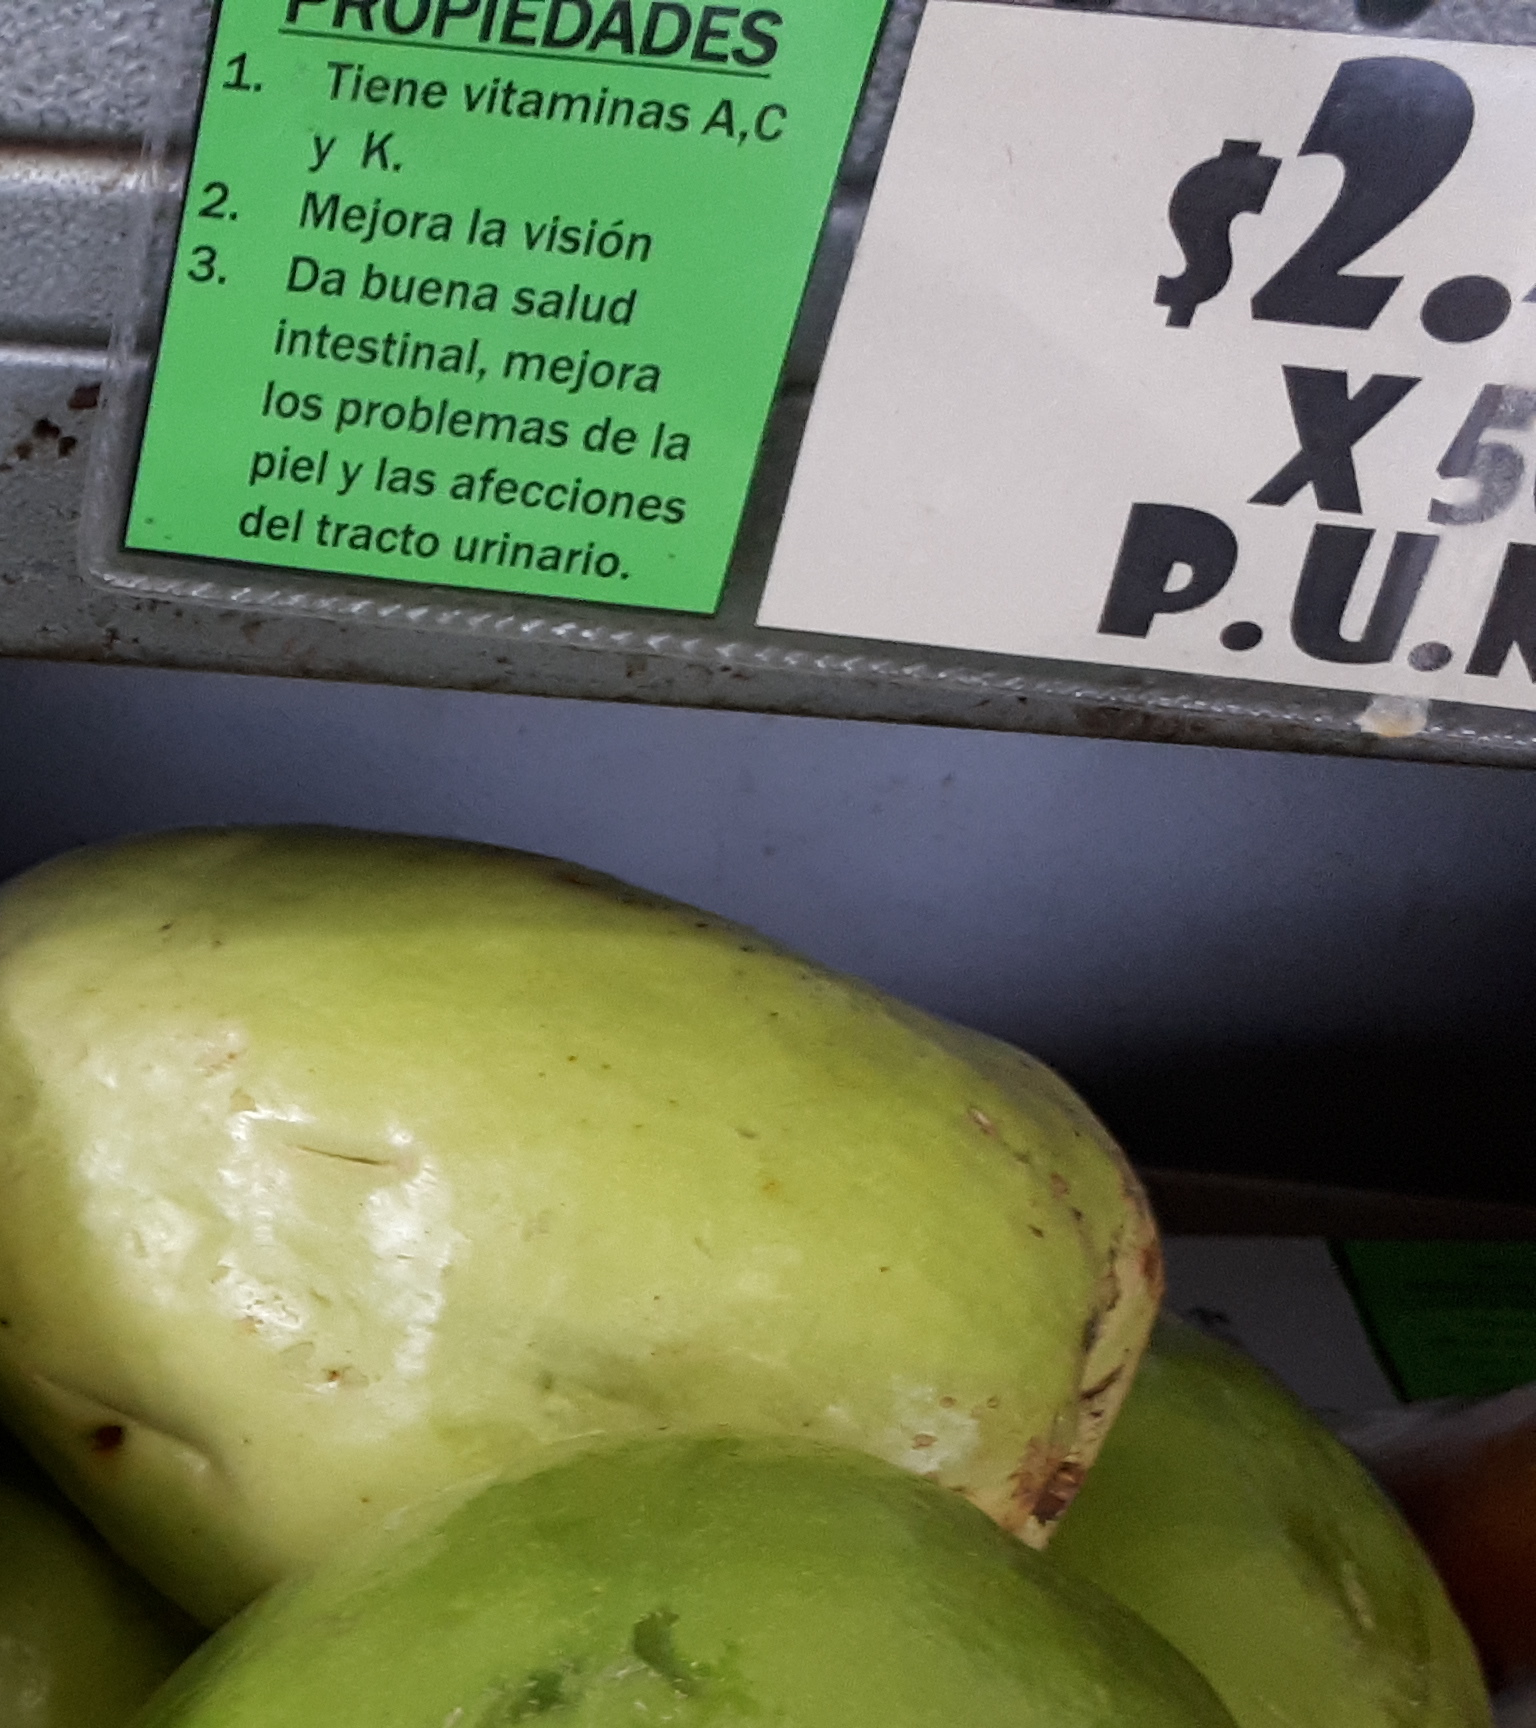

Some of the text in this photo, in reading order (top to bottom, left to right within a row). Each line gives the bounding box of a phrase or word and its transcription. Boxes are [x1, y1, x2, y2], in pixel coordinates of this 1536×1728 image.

[222, 52, 788, 146] 1. Tiene vitaminas A,C
[307, 130, 403, 173] y K.
[198, 181, 652, 263] 2. Mejora la visión
[1154, 56, 1536, 344] $2.
[187, 245, 638, 327] 3. Da buena salud
[273, 318, 662, 394] intestinal, mejora
[262, 379, 692, 462] los problemas de la
[248, 445, 688, 526] piel y las afecciones
[238, 504, 631, 581] del tracto urinario.
